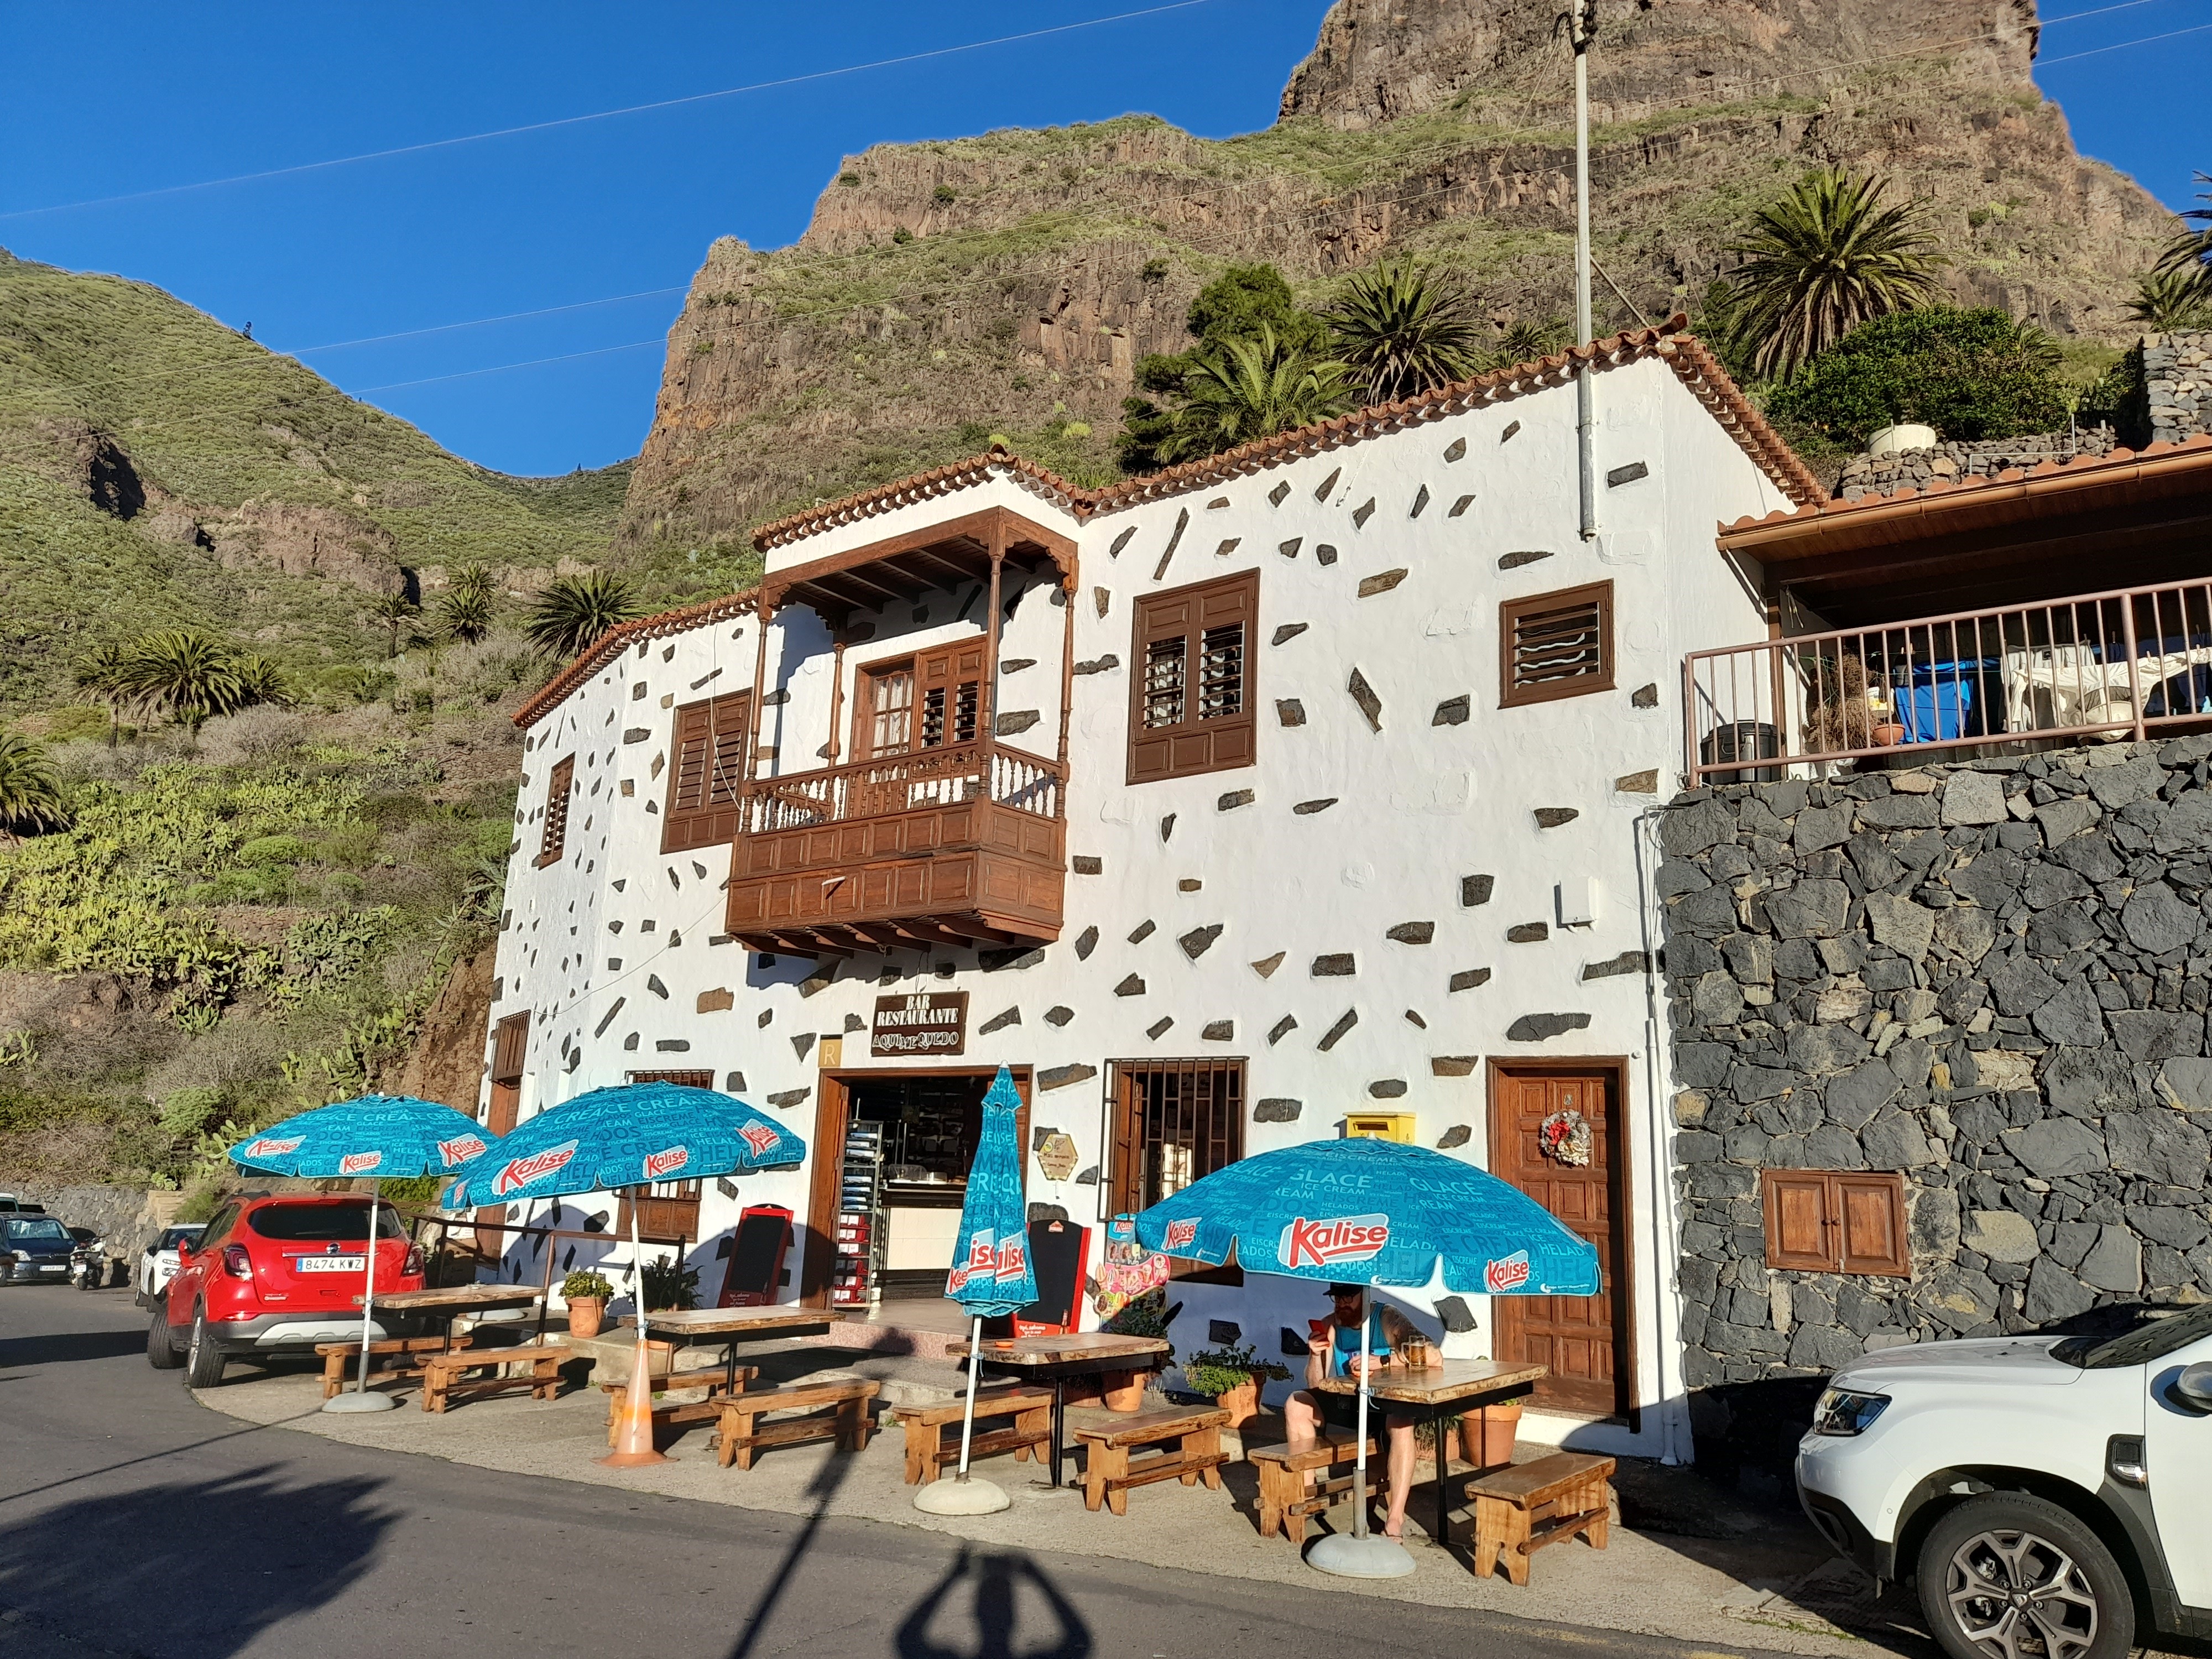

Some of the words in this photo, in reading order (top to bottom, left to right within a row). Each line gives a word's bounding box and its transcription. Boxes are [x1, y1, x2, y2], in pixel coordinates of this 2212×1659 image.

[906, 995, 930, 1010] BAR
[877, 1008, 958, 1026] RESTAURANTE
[917, 1031, 959, 1050] QUEDO
[824, 1044, 836, 1065] R
[635, 1109, 666, 1118] GLACE
[638, 1112, 695, 1125] EISCREME
[543, 1122, 573, 1133] GLACE
[735, 1125, 775, 1158] Kalise
[439, 1139, 484, 1166] Kalise
[343, 1154, 380, 1173] Kalise
[500, 1150, 574, 1194] Kalise
[646, 1150, 687, 1177] Kalise
[1301, 1182, 1320, 1191] ICE
[1323, 1185, 1365, 1195] CREAM
[1321, 1202, 1359, 1210] HELADOS
[1451, 1194, 1488, 1203] CREAM
[1392, 1221, 1420, 1229] CREAM
[1166, 1220, 1196, 1250] Kalise
[1289, 1218, 1387, 1267] Kalise
[1528, 1234, 1547, 1242] ICE
[306, 1260, 335, 1270] 8474
[340, 1259, 361, 1269] KWZ
[1488, 1259, 1528, 1291] Kalise
